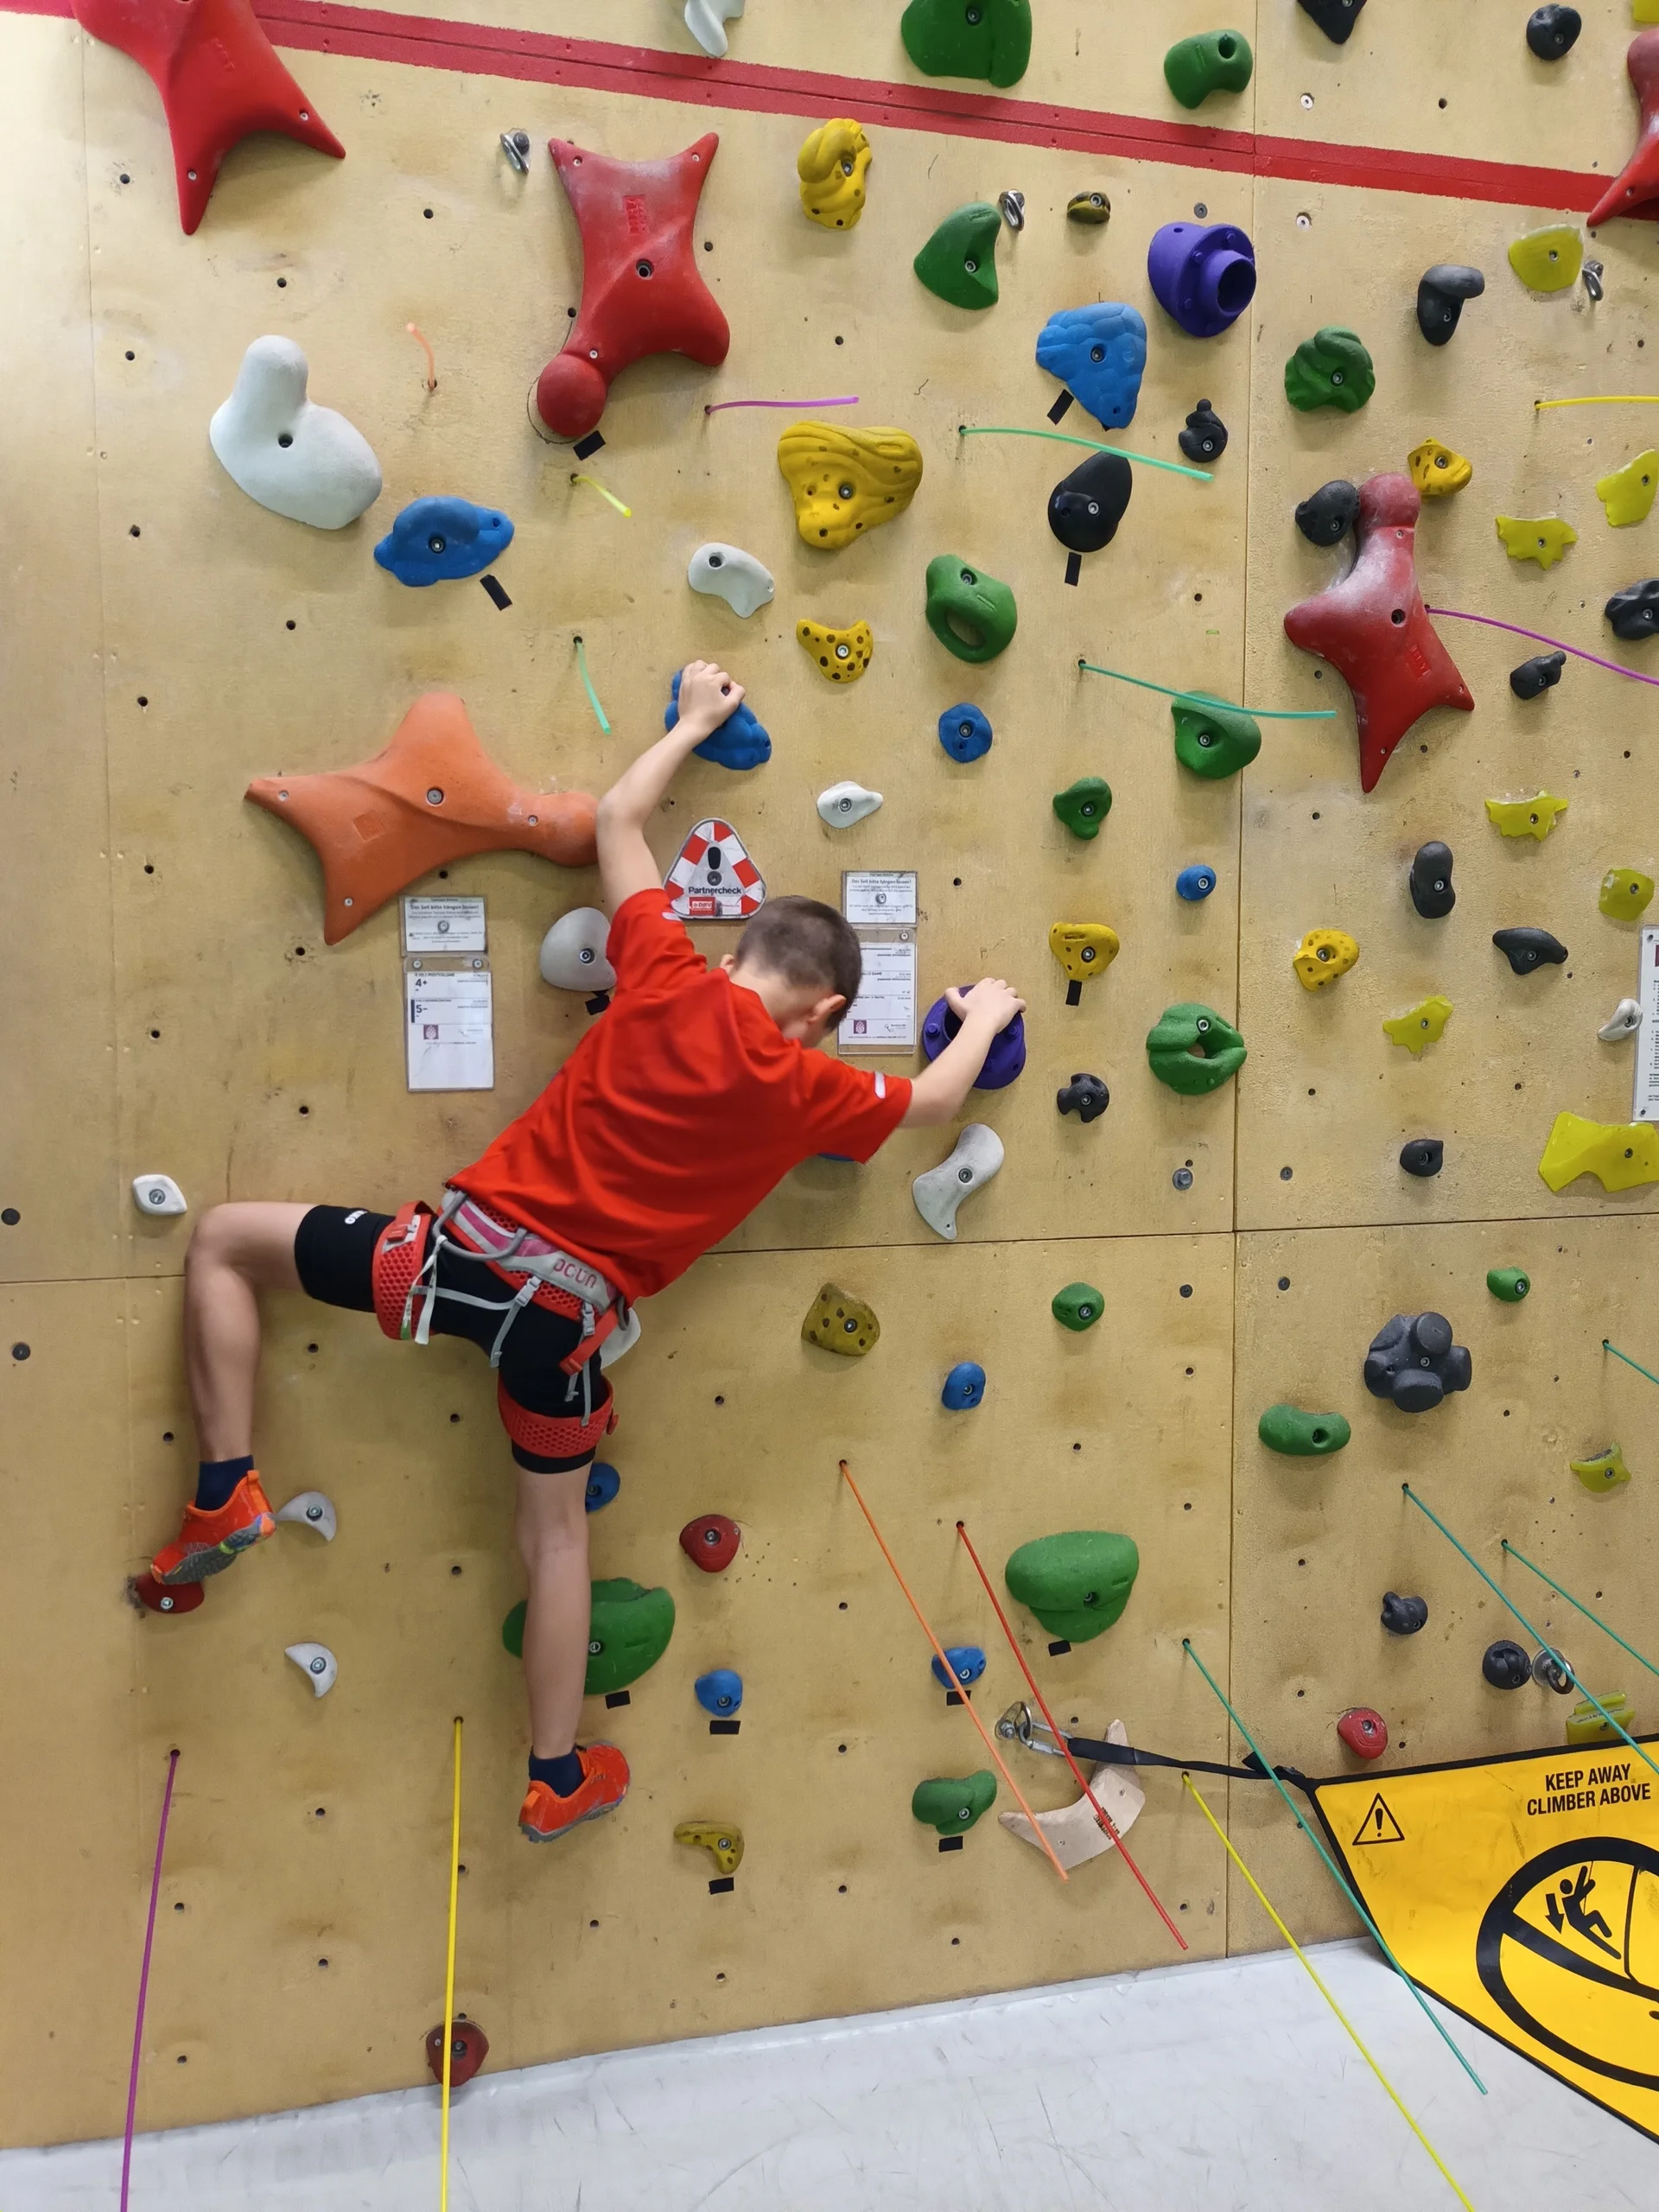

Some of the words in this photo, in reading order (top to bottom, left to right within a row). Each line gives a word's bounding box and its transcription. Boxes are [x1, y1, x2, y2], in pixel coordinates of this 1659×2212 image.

[415, 978, 428, 987] 4+
[416, 1004, 428, 1014] 5-
[1545, 1770, 1584, 1791] KEEP
[1588, 1764, 1631, 1785] AWAY
[1527, 1790, 1596, 1815] CLIMBER
[1599, 1783, 1651, 1805] ABOVE
